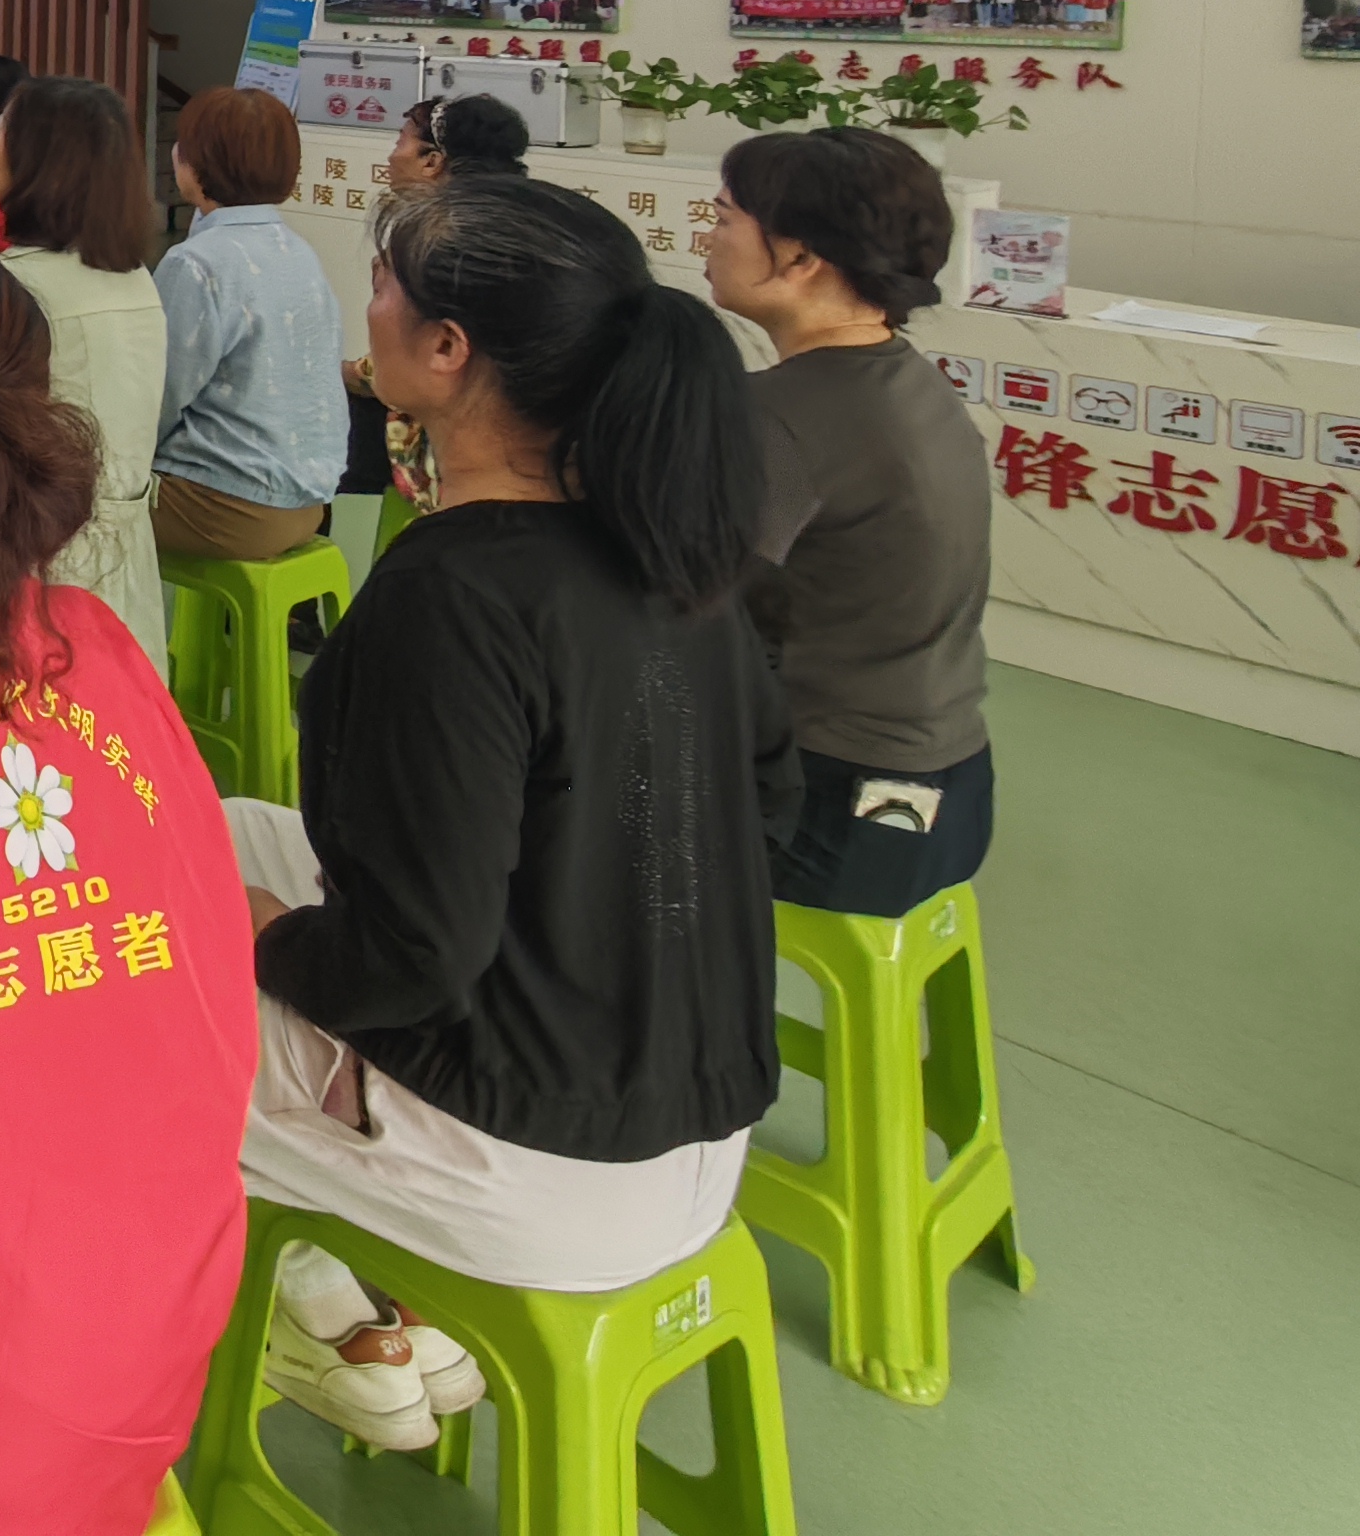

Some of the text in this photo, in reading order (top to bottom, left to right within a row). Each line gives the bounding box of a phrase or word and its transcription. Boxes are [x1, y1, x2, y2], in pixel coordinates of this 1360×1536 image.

[323, 73, 391, 91] 便民服务箱
[1, 876, 111, 925] 5210
